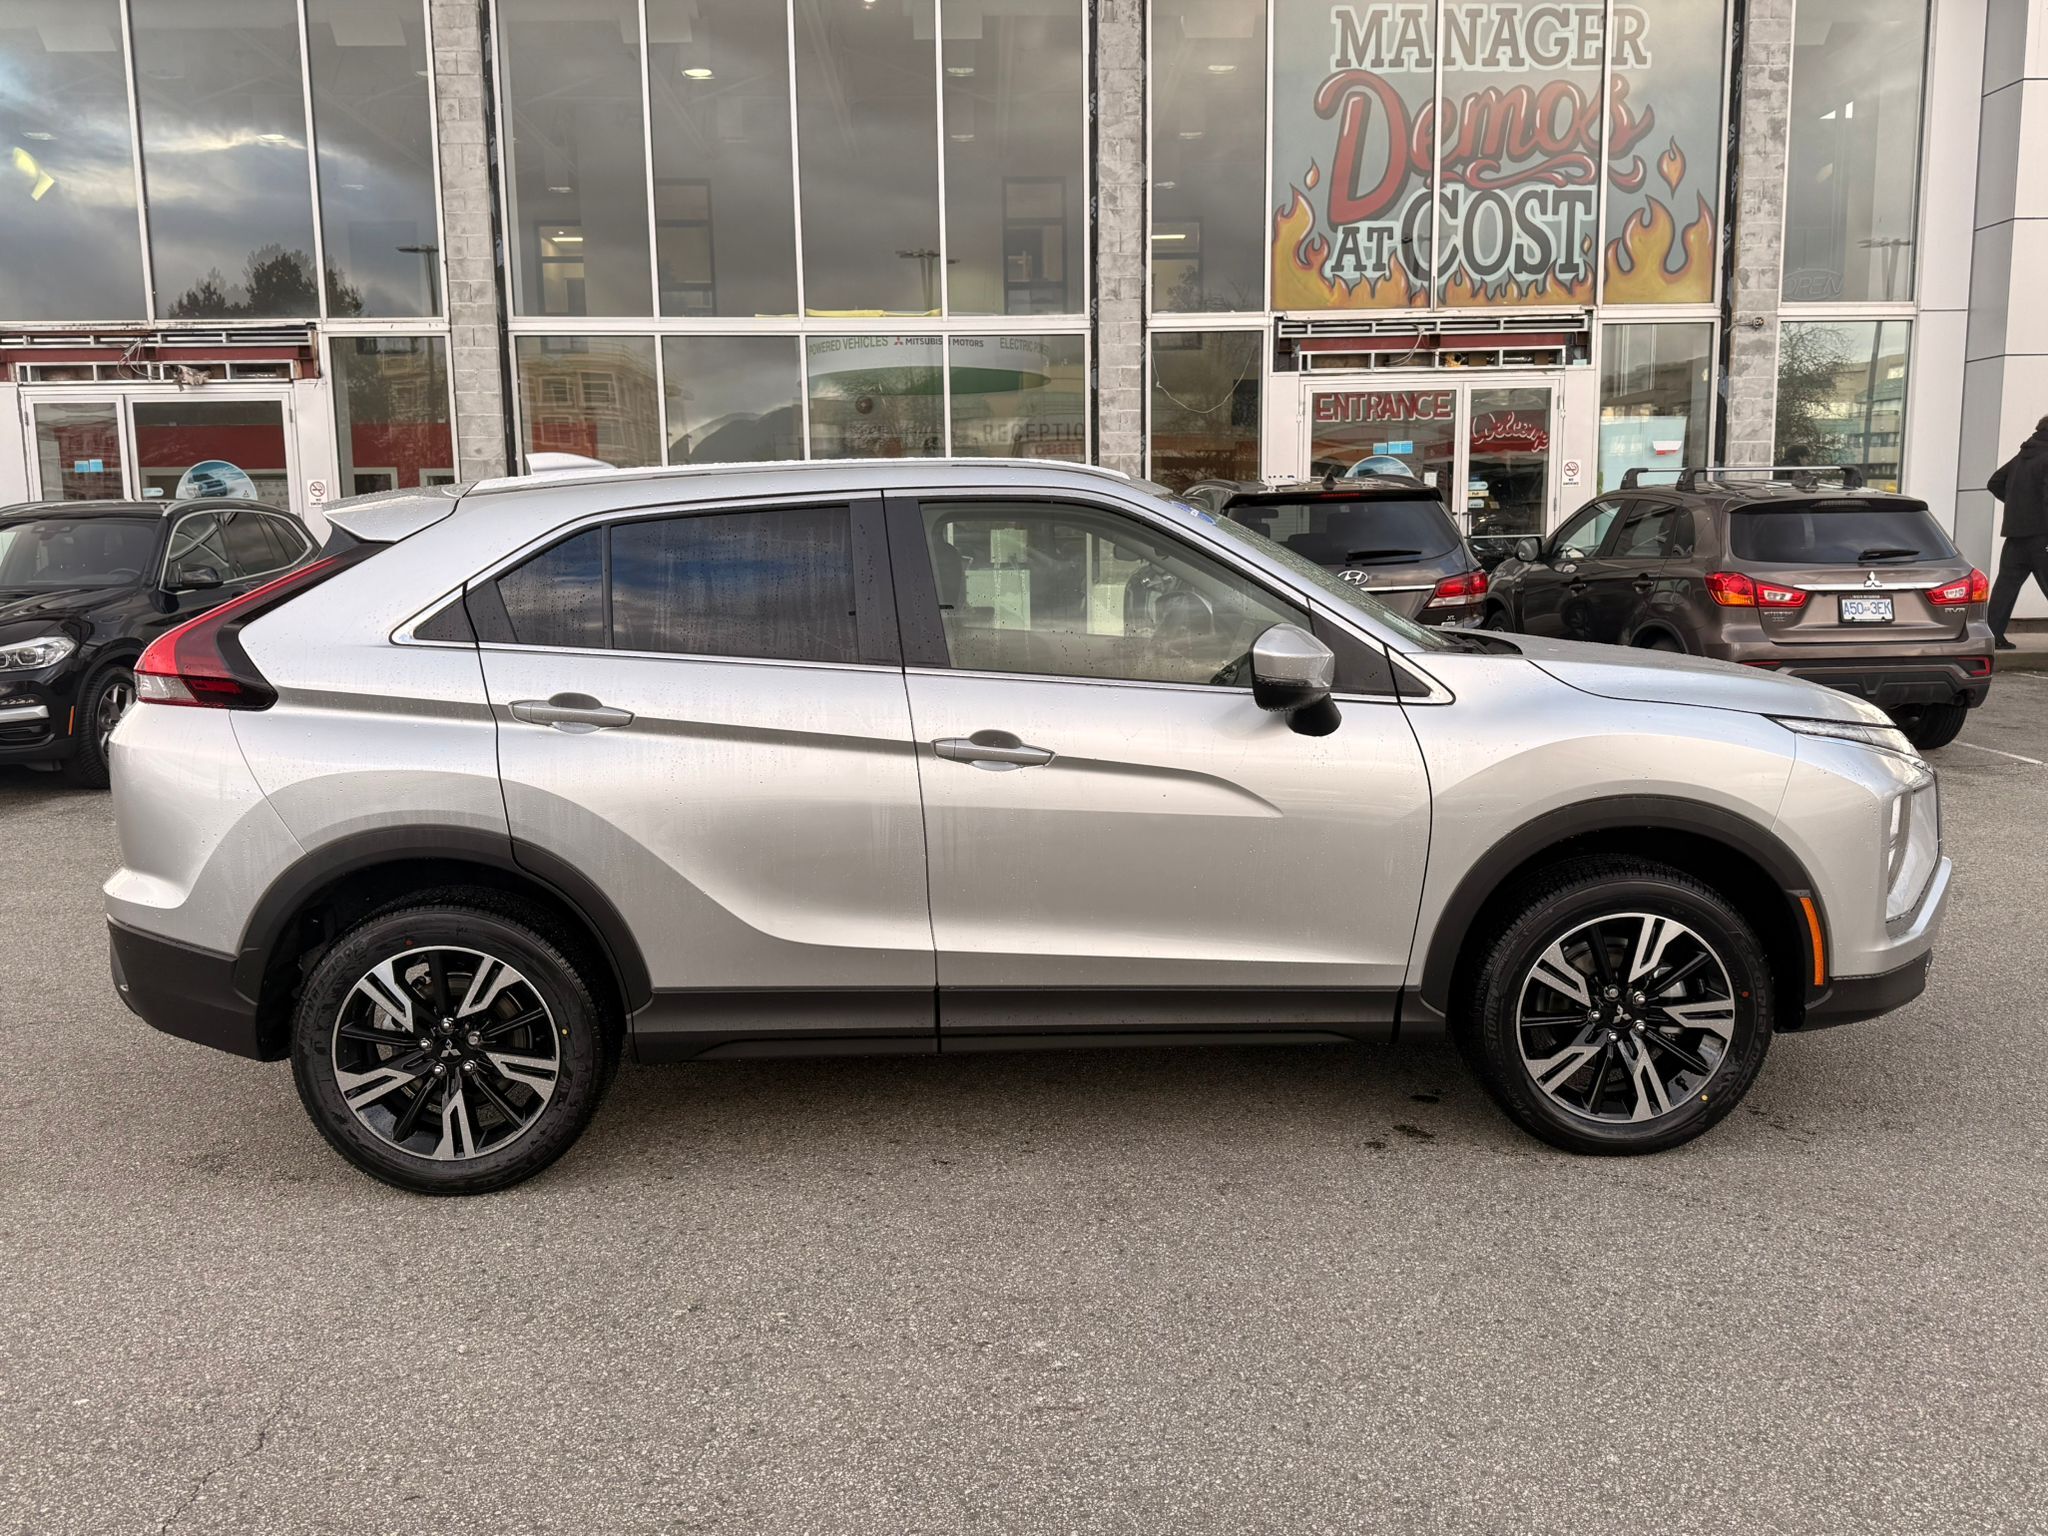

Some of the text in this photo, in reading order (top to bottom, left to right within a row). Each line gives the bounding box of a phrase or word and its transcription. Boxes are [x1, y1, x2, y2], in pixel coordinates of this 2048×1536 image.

[1332, 4, 1652, 71] MANAGER
[1313, 69, 1655, 229] Demos
[1330, 184, 1597, 281] AT COST
[843, 335, 889, 350] VEHICLES
[952, 338, 984, 348] MOTORS
[1315, 391, 1454, 423] ENTRANCE
[1472, 411, 1549, 453] Welcome
